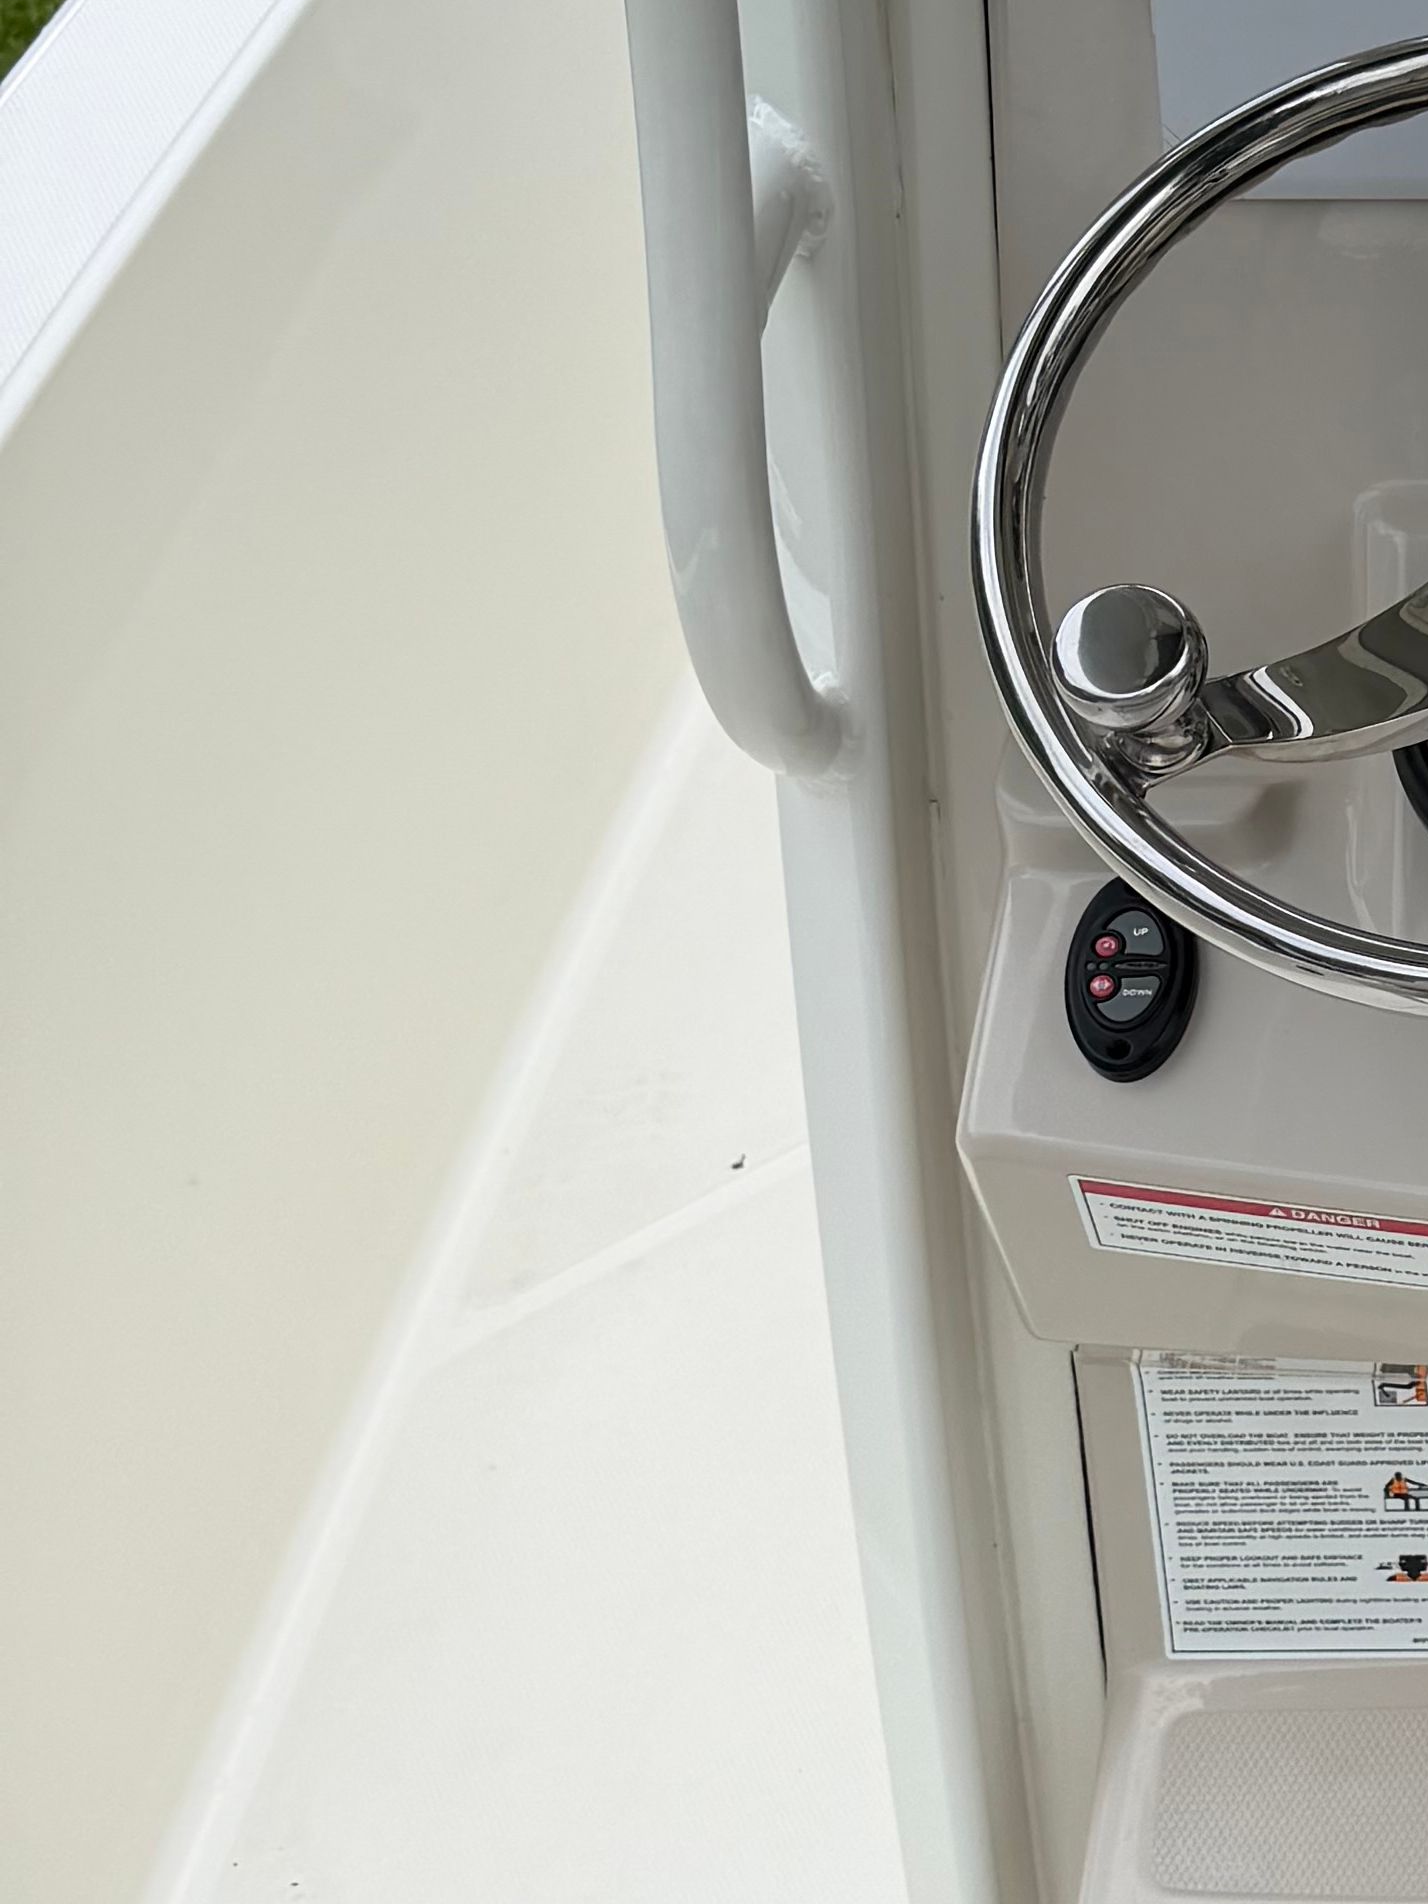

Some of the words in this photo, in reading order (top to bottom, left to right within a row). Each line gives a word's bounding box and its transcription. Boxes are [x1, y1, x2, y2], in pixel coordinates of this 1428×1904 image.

[1133, 927, 1149, 937] UP
[1122, 988, 1153, 997] DOWN
[1290, 1208, 1380, 1229] DANGER
